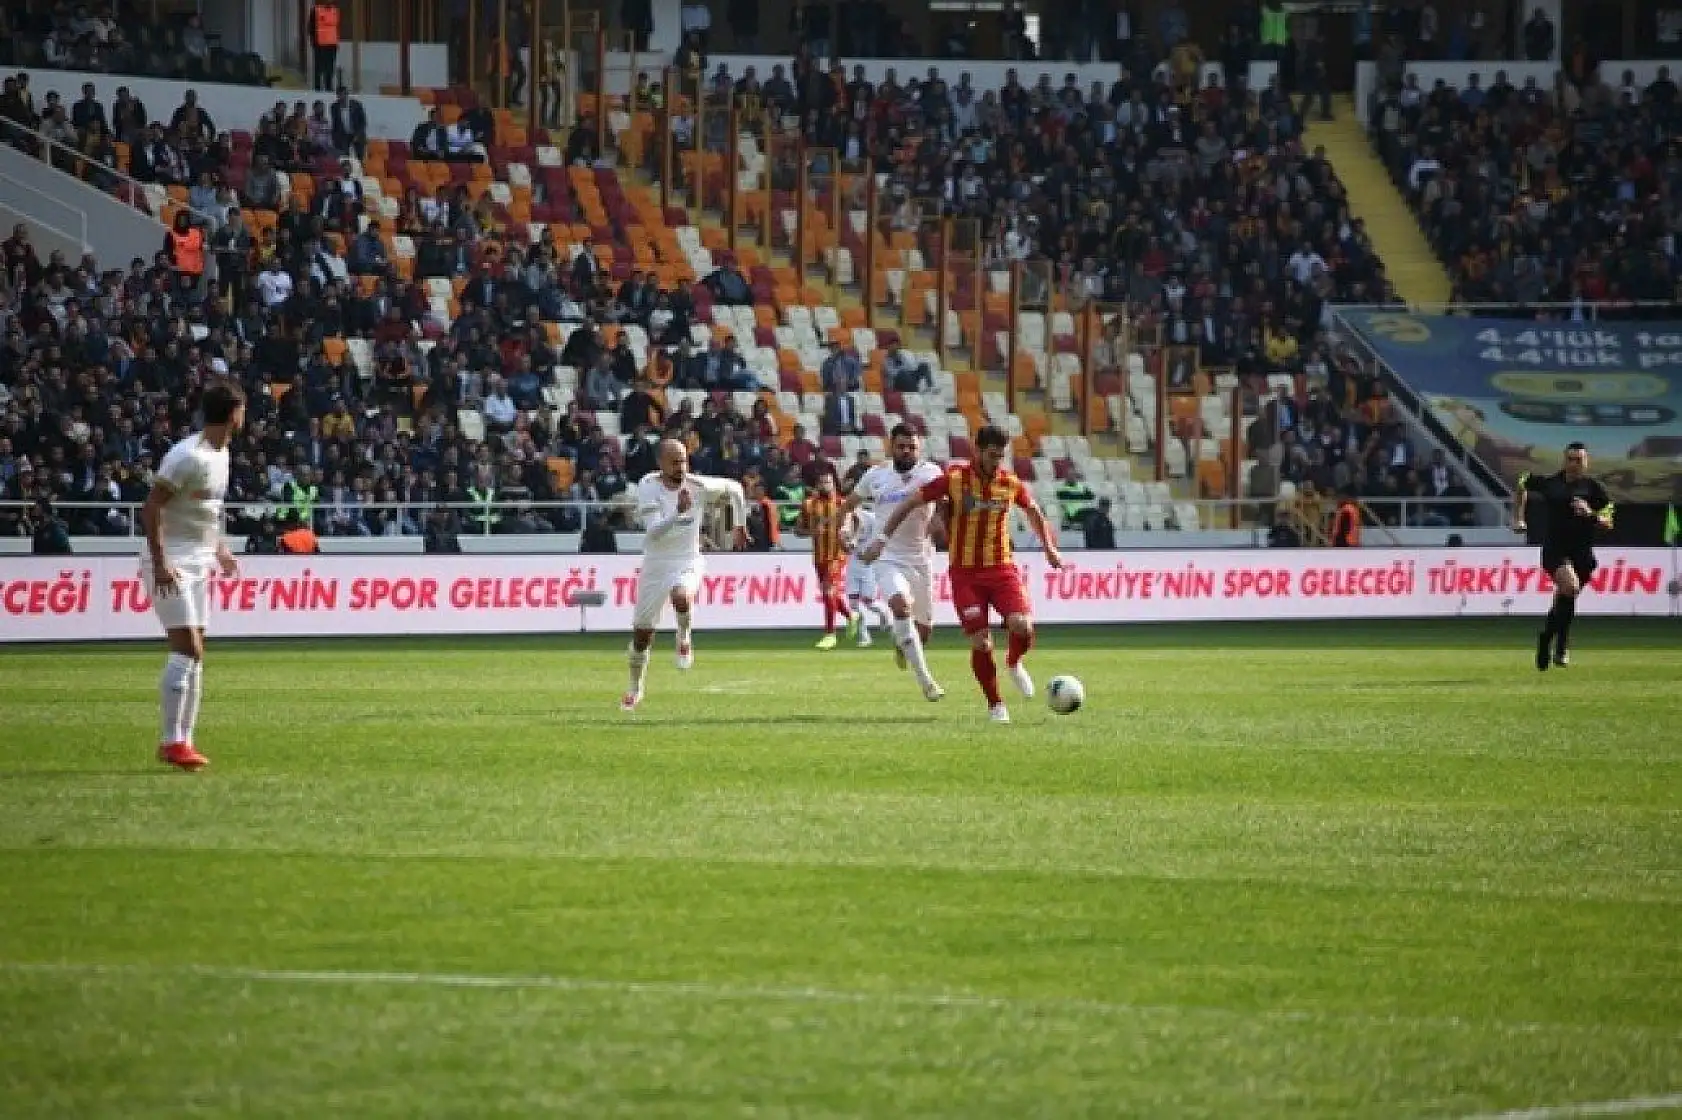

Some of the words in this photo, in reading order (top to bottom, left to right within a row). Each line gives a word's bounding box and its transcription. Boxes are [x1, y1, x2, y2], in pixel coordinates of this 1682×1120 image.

[0, 570, 91, 613] CEĞİ
[349, 577, 438, 609] SPOR
[1043, 561, 1216, 600] TÜRKİYE'NİN
[1222, 569, 1292, 597] SPOR
[1300, 560, 1414, 596] GELECEĞİ
